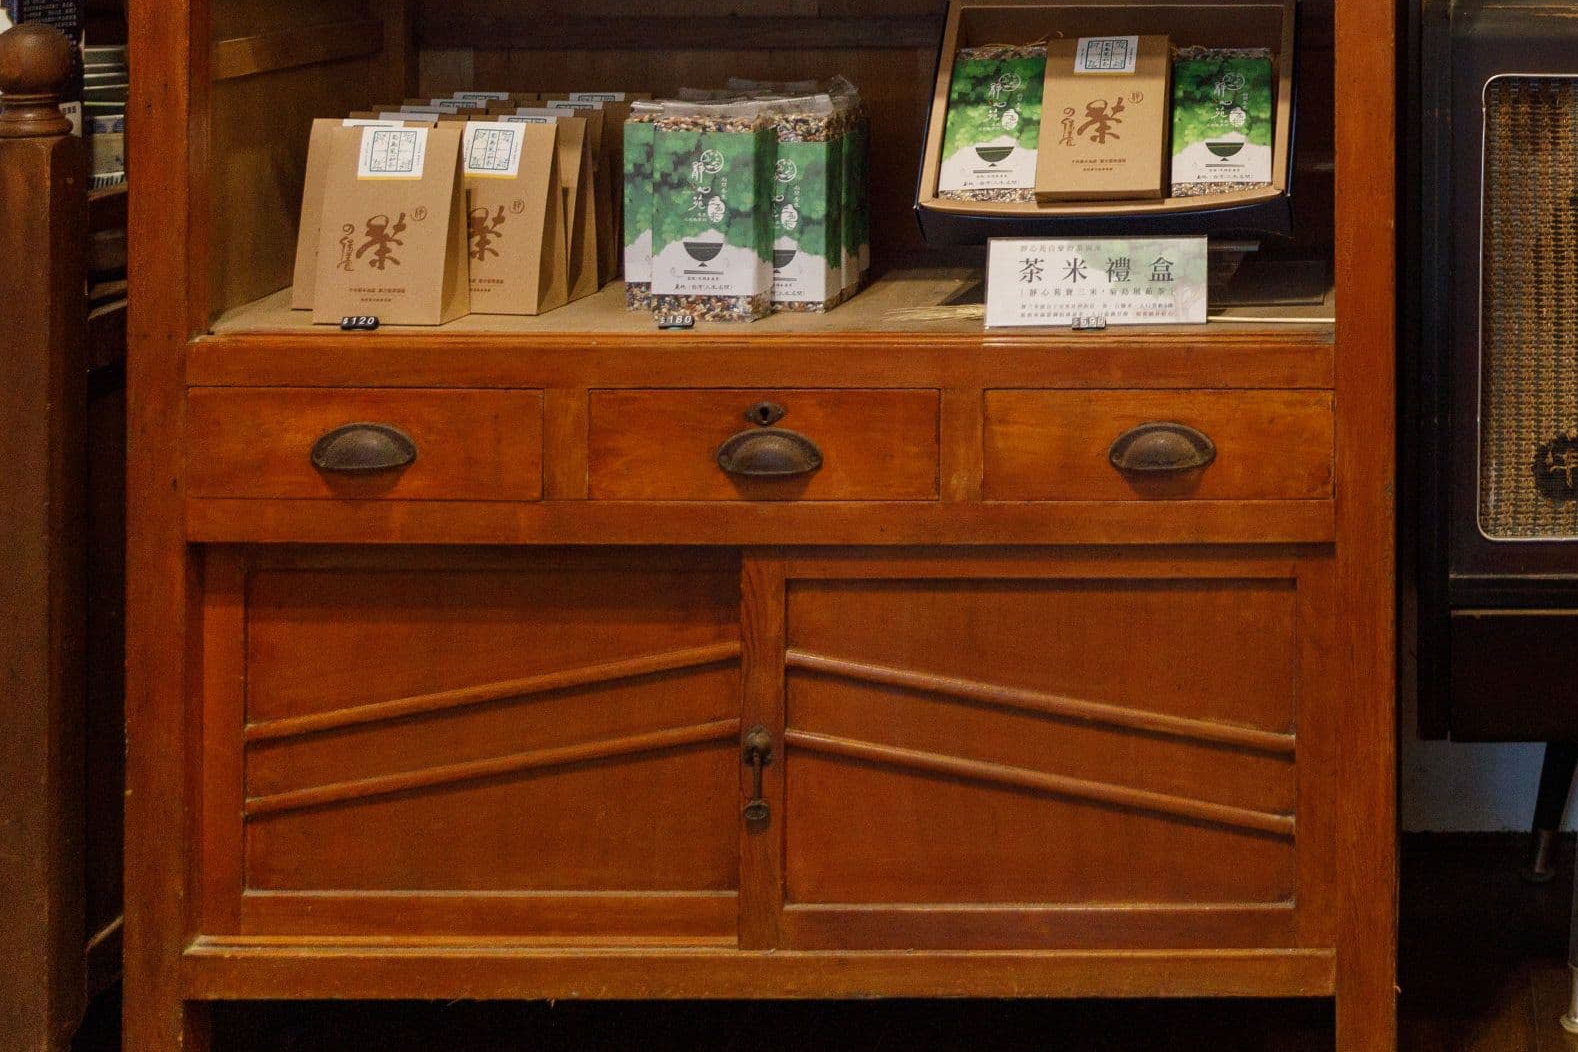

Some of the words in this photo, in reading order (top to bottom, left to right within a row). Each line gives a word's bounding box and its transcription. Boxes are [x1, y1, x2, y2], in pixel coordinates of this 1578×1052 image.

[1018, 256, 1175, 284] 茶米禮盒
[341, 316, 375, 325] $120
[659, 315, 692, 325] $180
